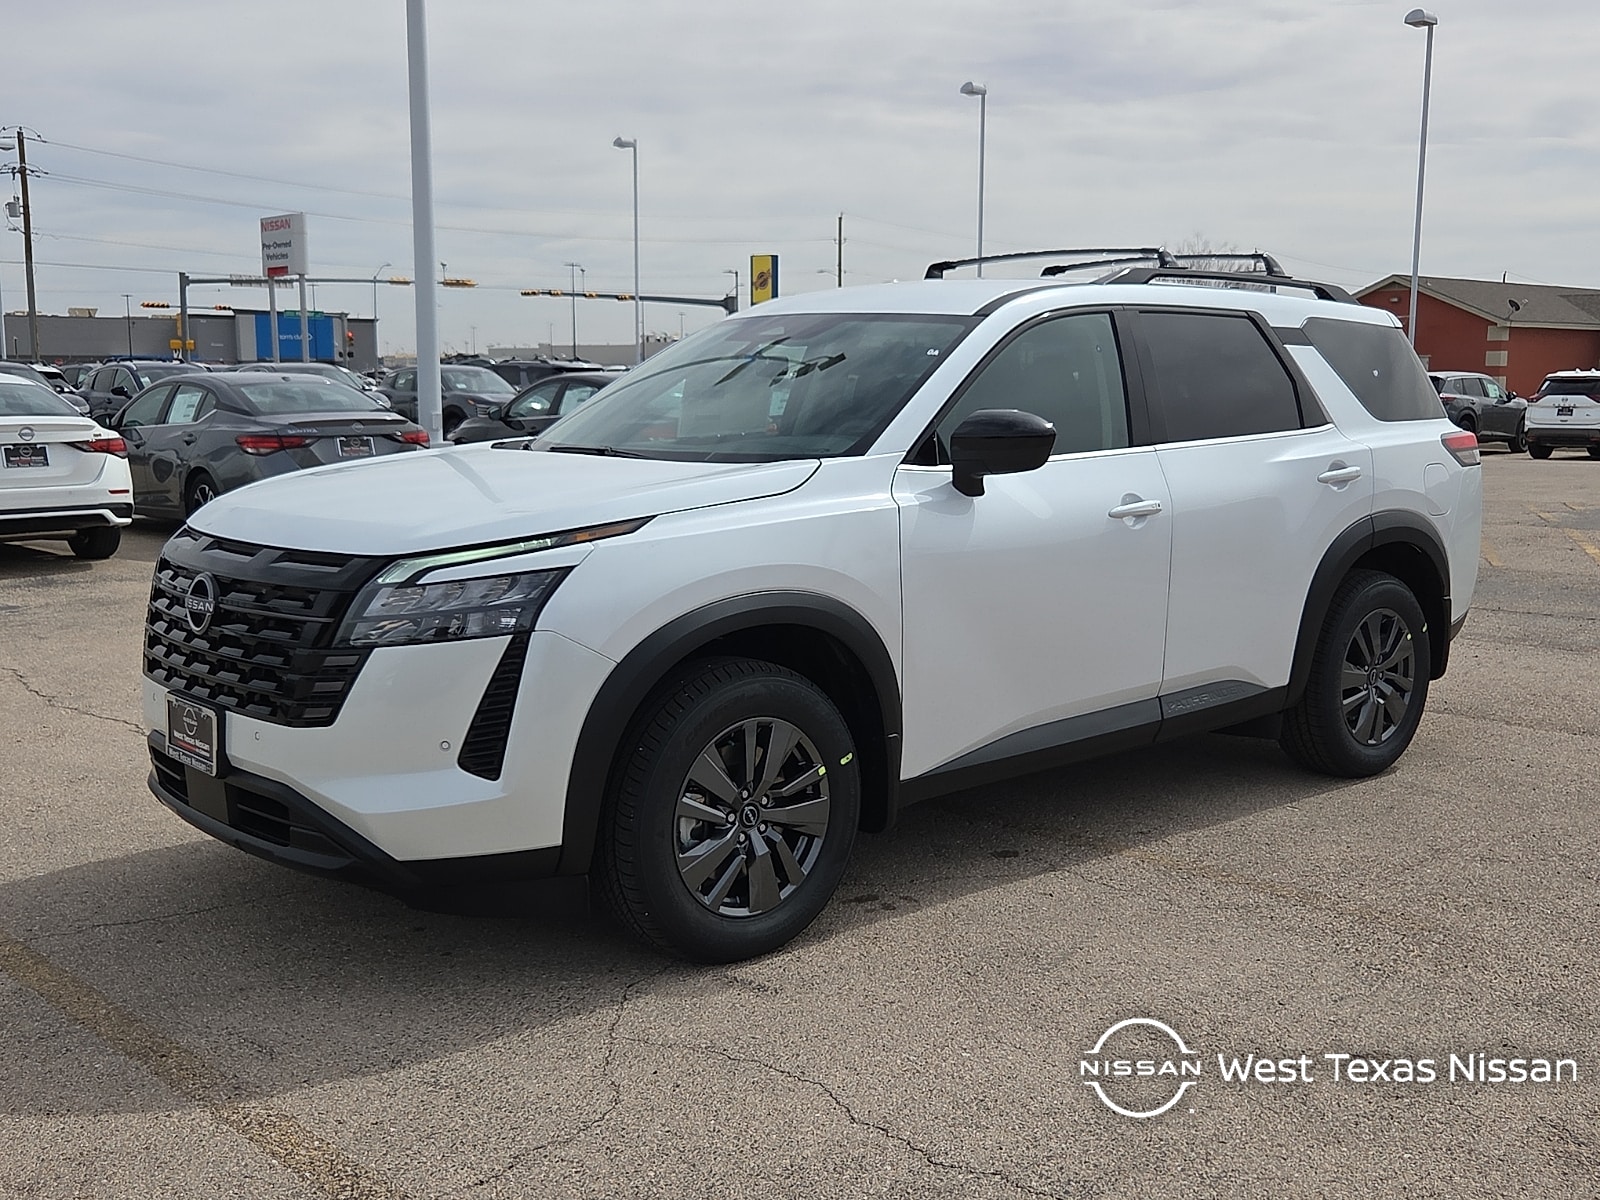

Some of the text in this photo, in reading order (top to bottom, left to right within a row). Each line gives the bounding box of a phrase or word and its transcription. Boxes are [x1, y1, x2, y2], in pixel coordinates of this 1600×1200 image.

[261, 218, 291, 232] NISSAN
[262, 240, 291, 250] Pre-Owned
[266, 252, 289, 261] Vehicles
